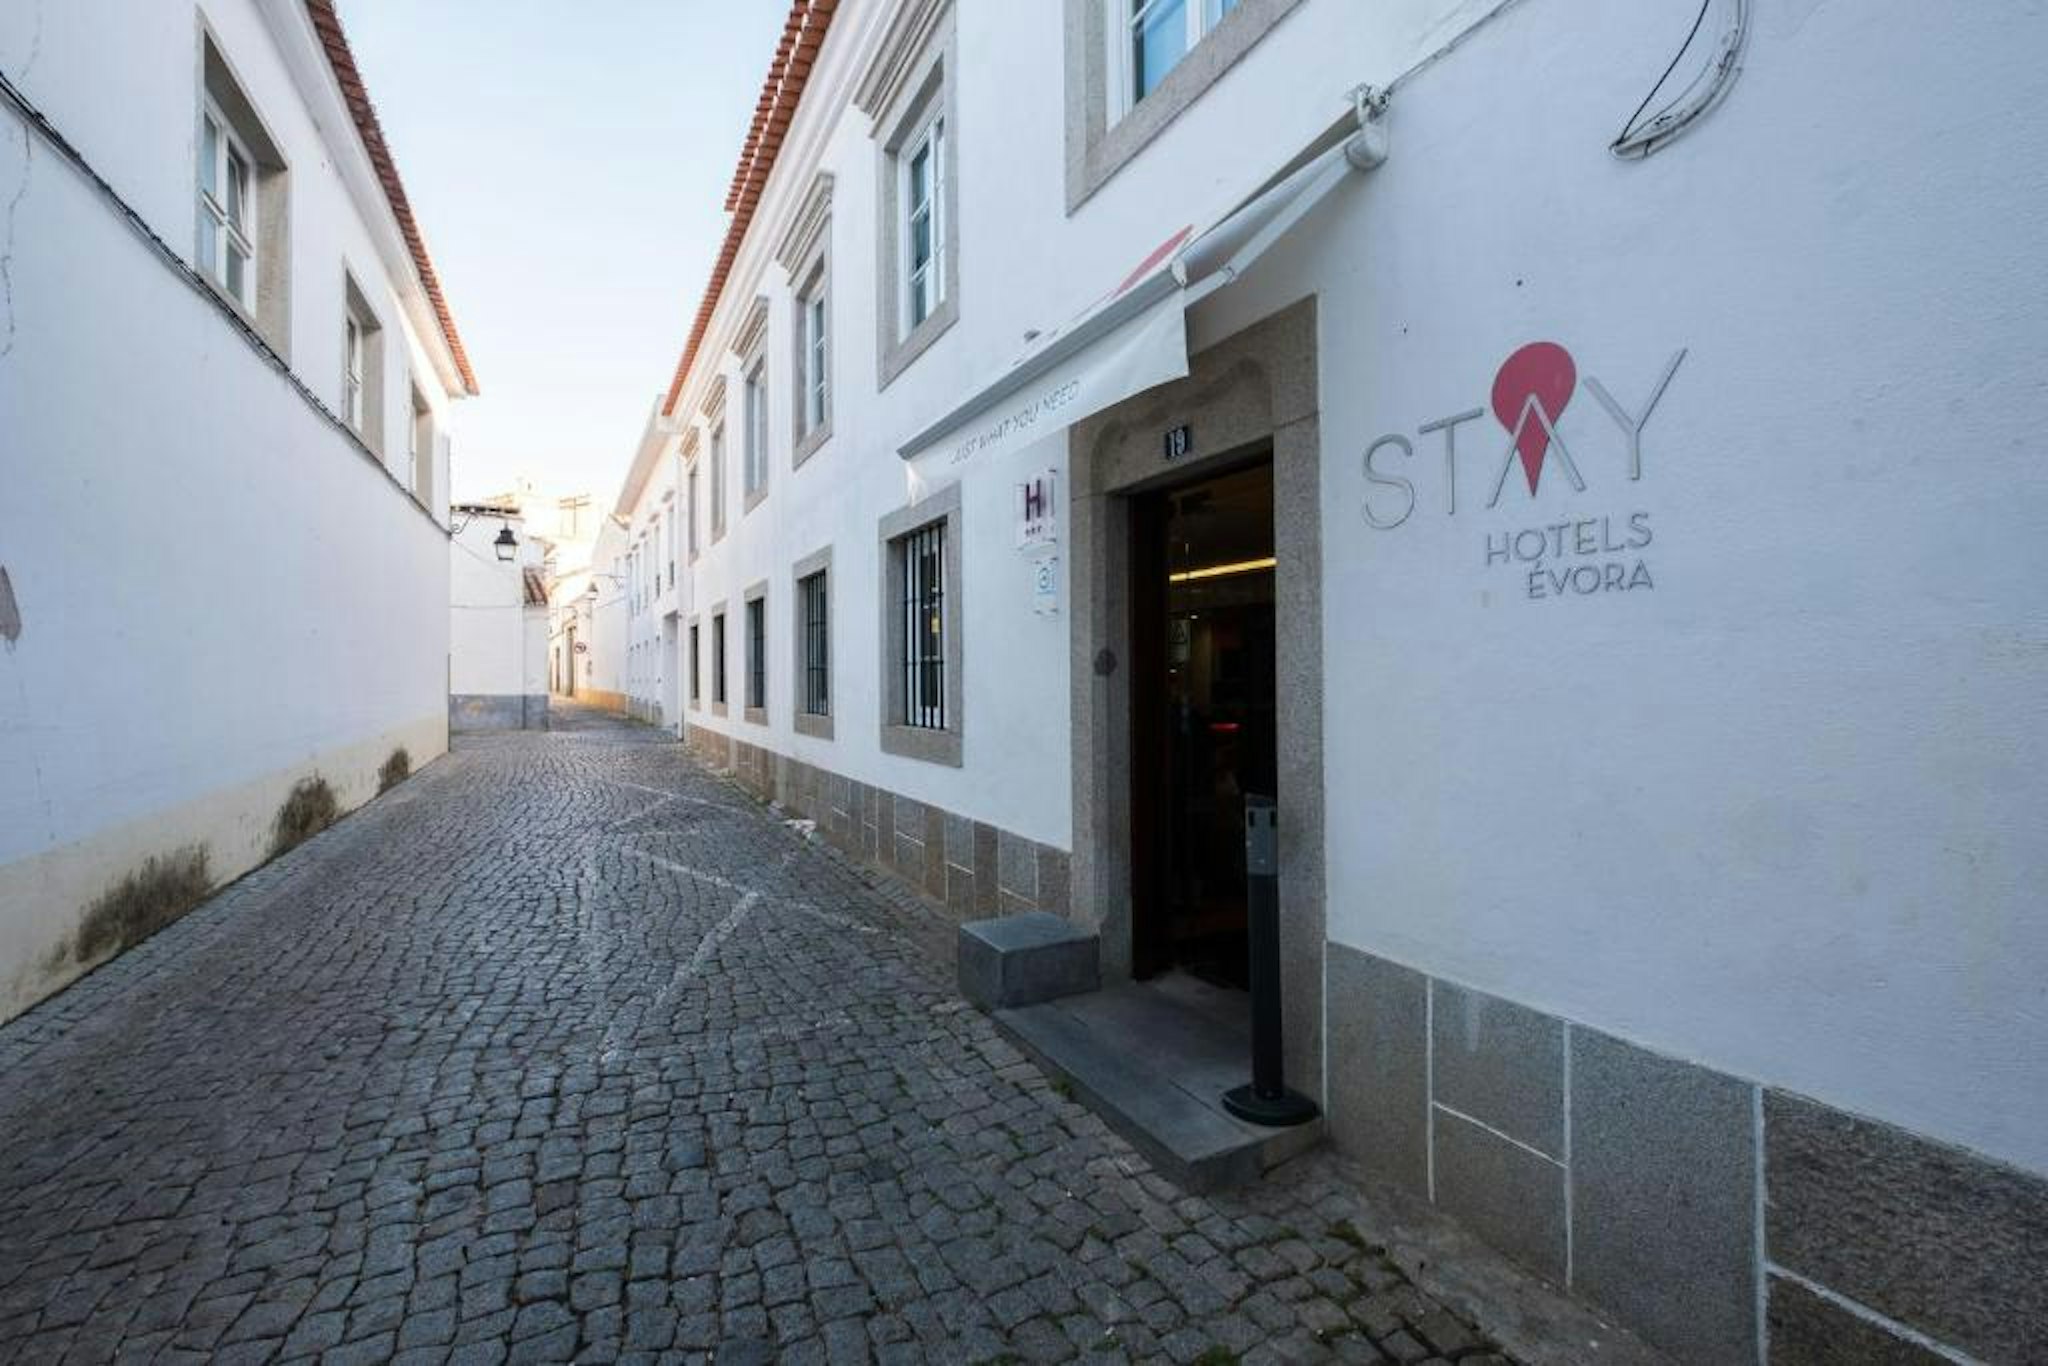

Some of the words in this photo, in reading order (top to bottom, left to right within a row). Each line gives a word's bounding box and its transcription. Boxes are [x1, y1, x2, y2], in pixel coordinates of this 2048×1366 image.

[1012, 403, 1040, 431] YOU
[1169, 429, 1186, 457] 19
[1362, 347, 1688, 531] STAY
[1486, 511, 1653, 567] HOTELS
[1528, 559, 1654, 600] ÉVORA
